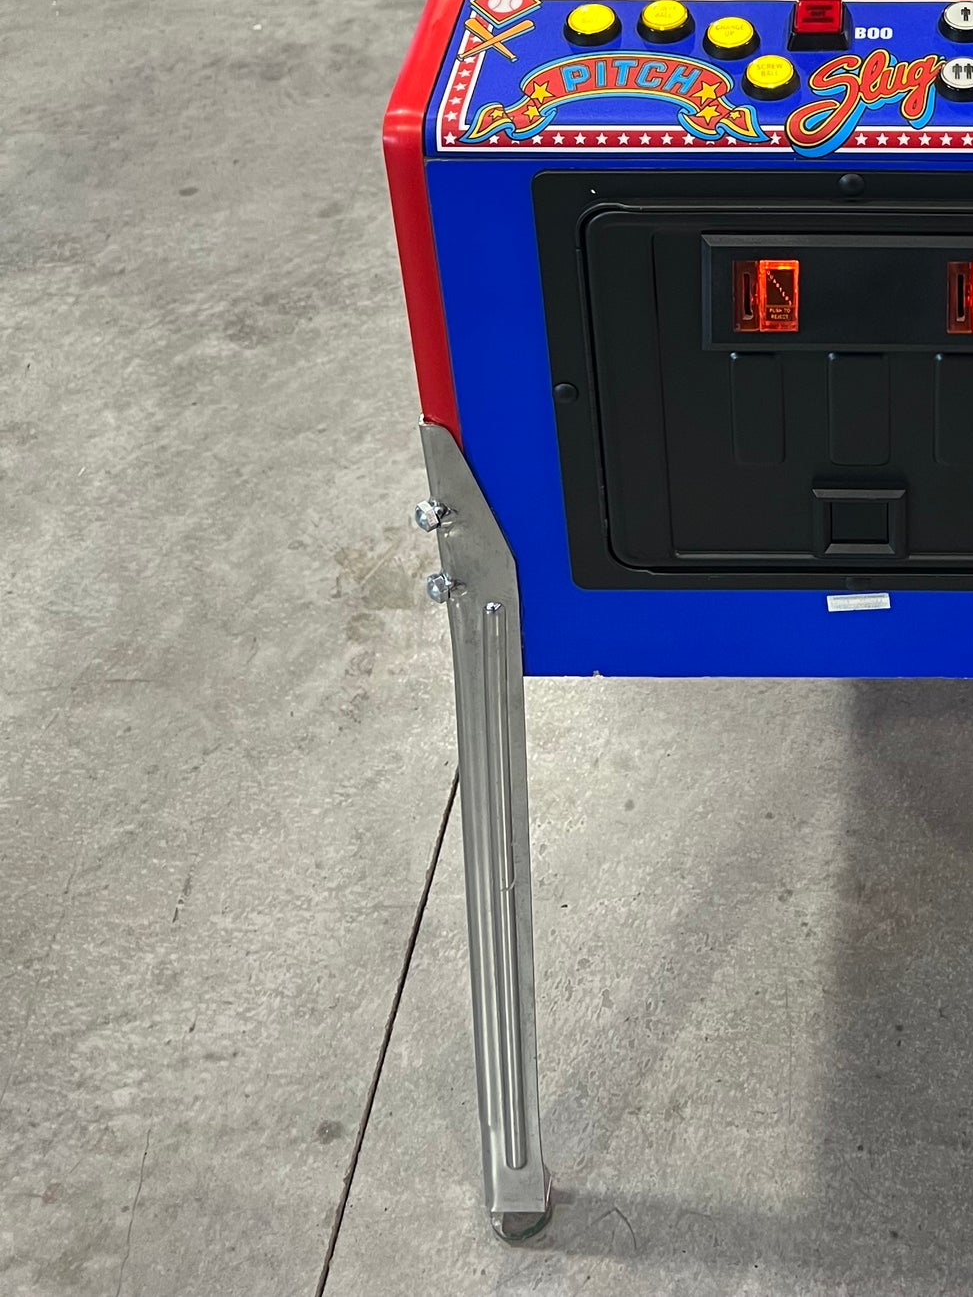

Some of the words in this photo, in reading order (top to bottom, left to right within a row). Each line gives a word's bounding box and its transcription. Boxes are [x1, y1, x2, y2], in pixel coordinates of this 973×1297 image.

[854, 27, 893, 40] BOO
[756, 63, 783, 71] SCREW
[760, 69, 780, 77] BALL
[560, 58, 704, 94] PITCH
[786, 49, 944, 155] Slug
